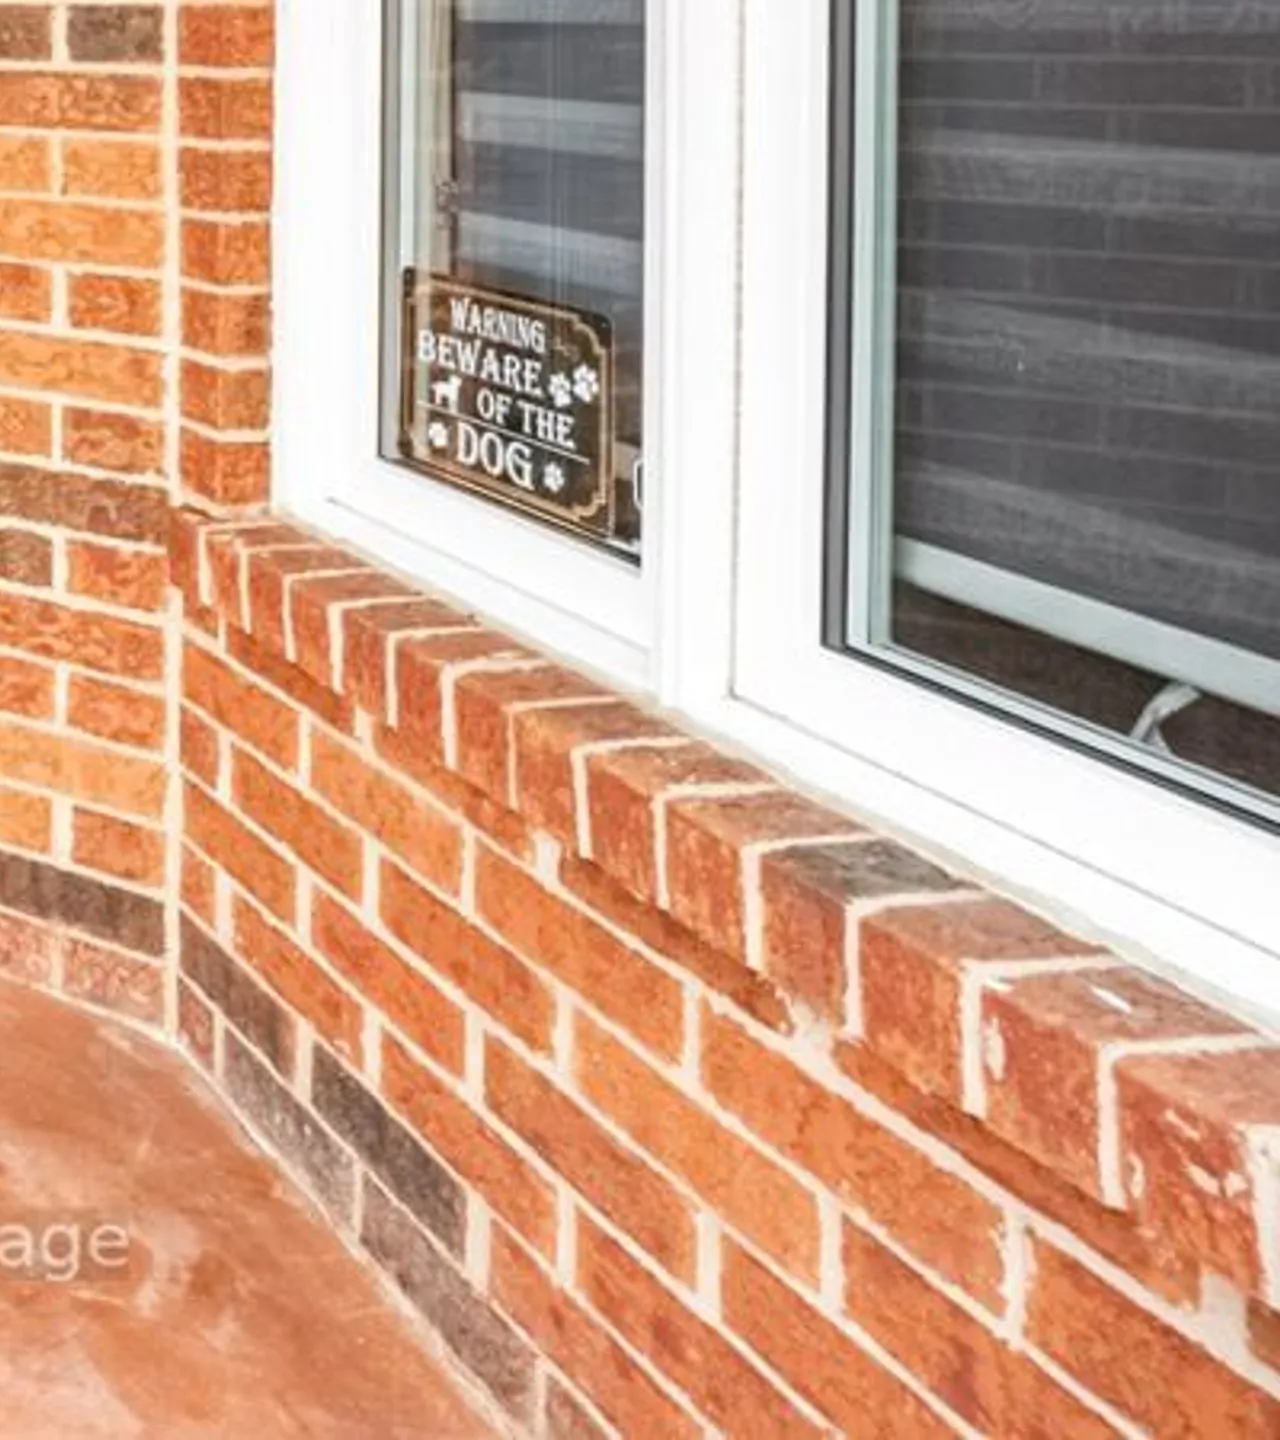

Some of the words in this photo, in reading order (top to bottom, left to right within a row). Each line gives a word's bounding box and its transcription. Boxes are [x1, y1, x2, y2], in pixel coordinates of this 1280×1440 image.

[451, 297, 545, 353] WARNING
[418, 329, 544, 397] BEWARE
[476, 389, 510, 426] OF
[517, 399, 575, 448] THE
[457, 422, 534, 491] DOG
